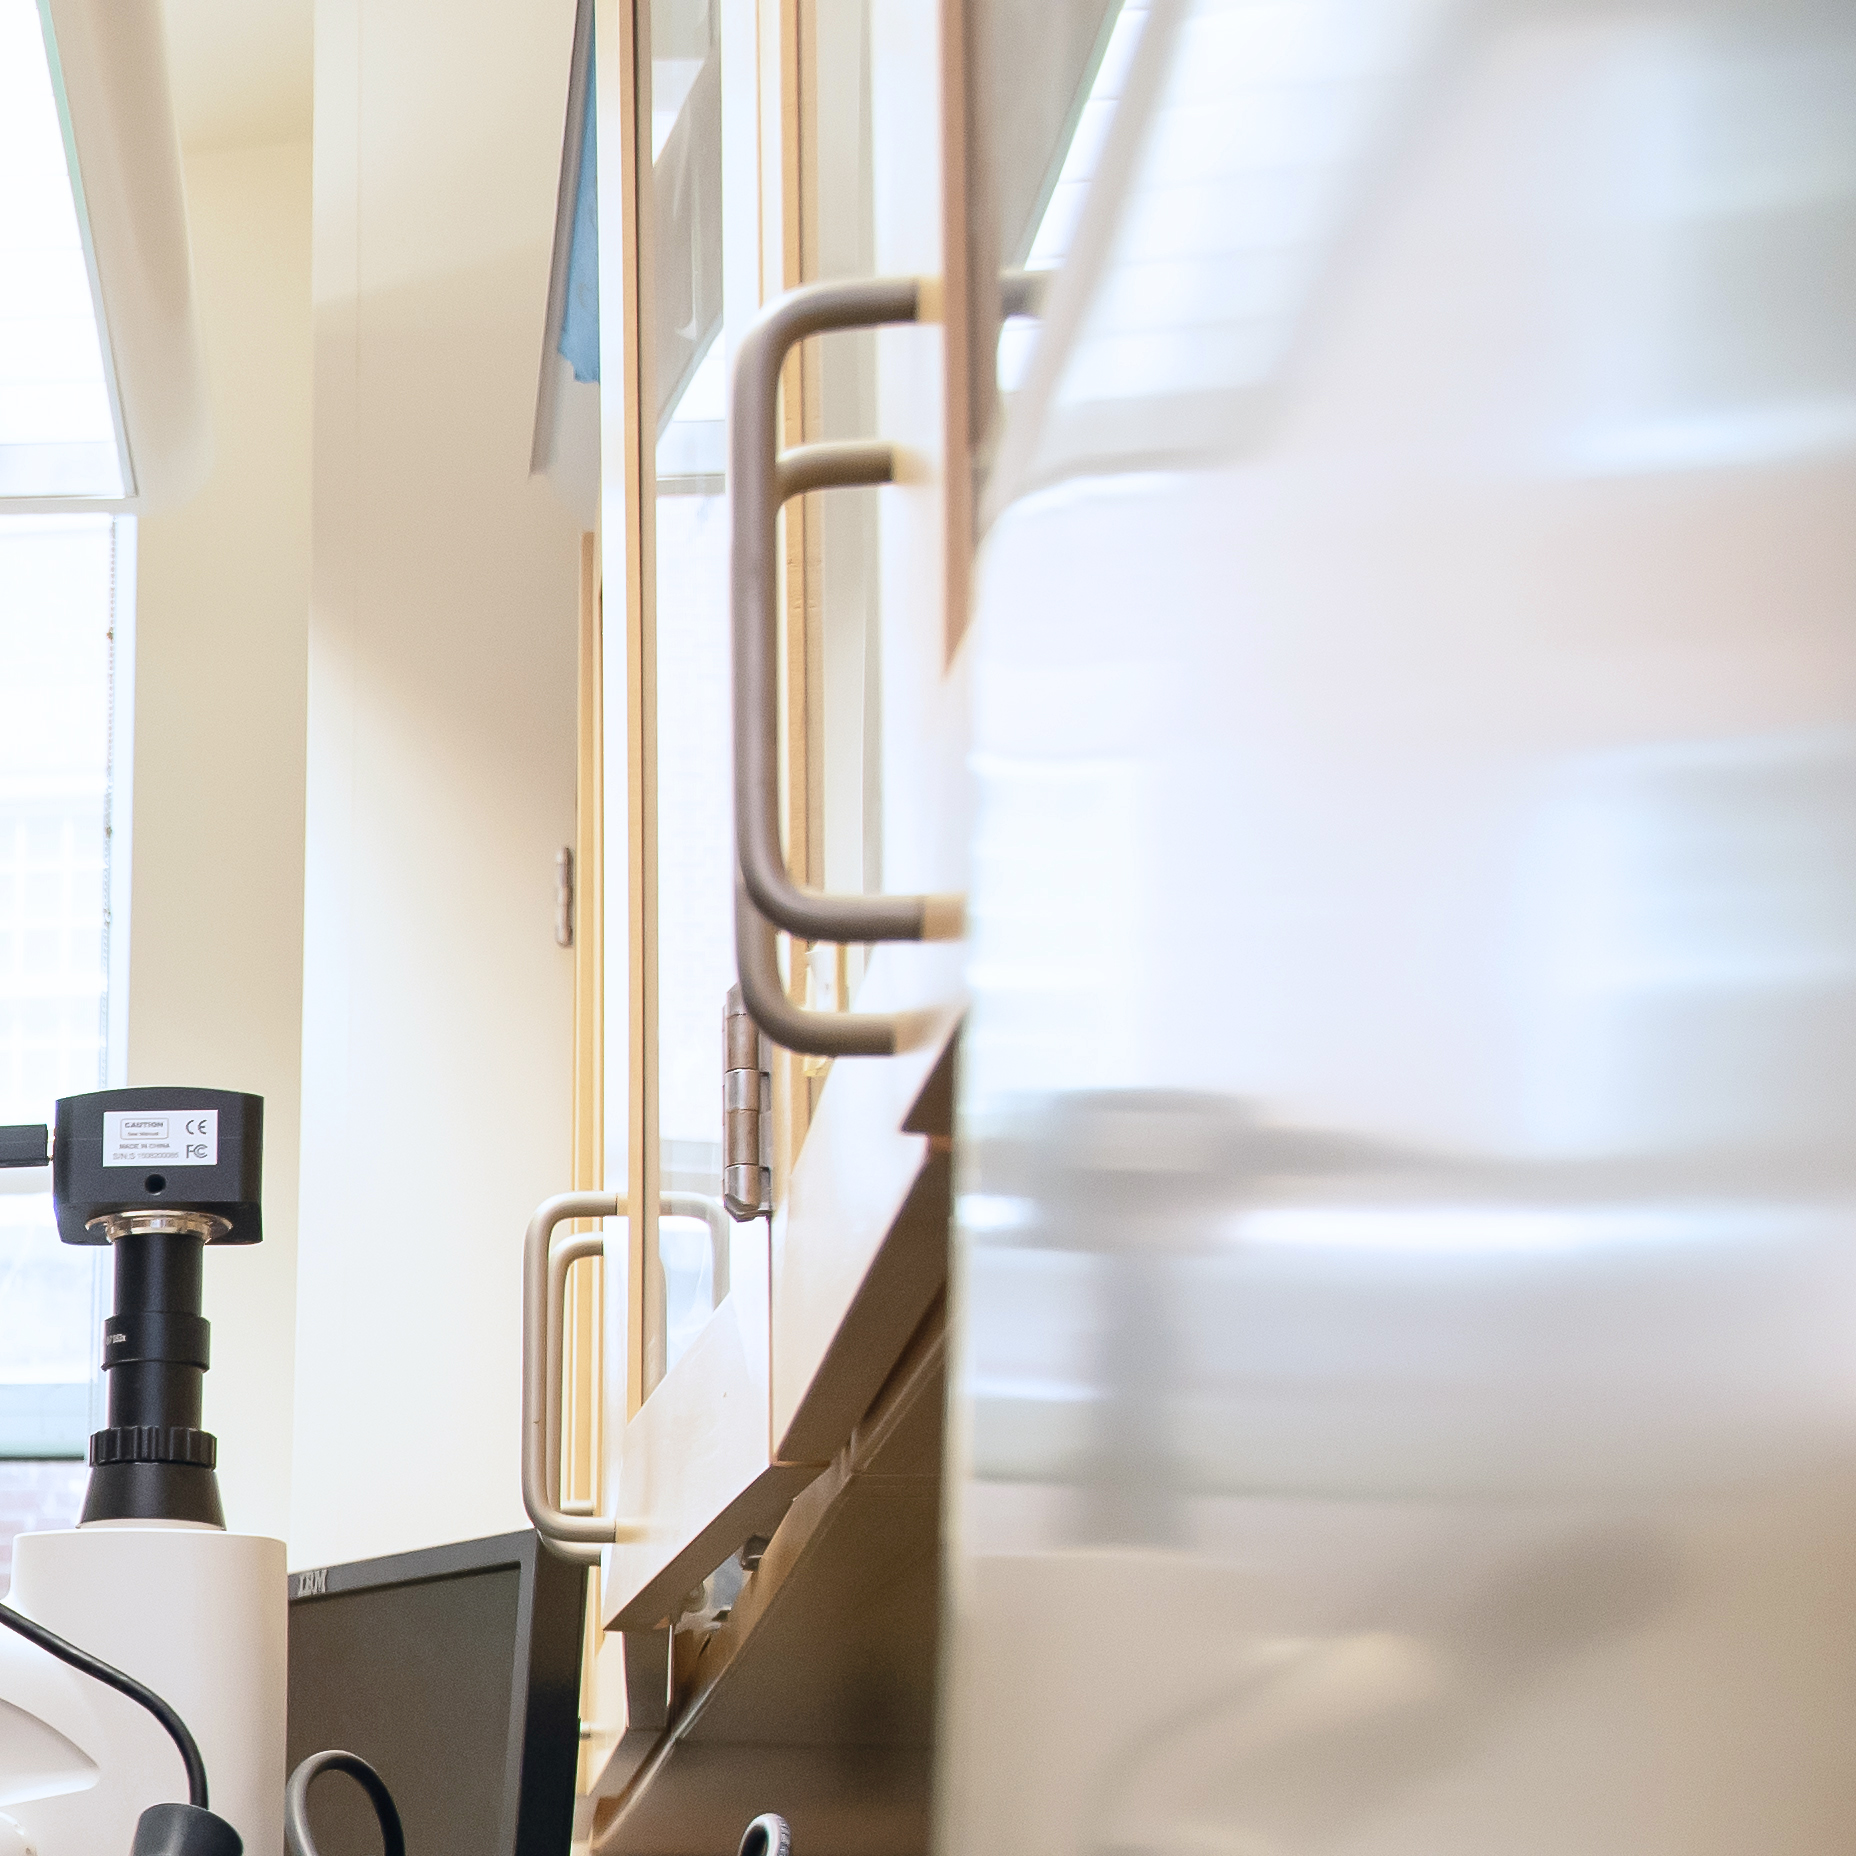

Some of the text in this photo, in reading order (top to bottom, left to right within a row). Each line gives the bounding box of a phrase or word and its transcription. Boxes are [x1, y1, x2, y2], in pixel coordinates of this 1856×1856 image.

[124, 1121, 164, 1129] CAUTION
[185, 1119, 208, 1135] CE
[298, 1569, 328, 1597] IBM
